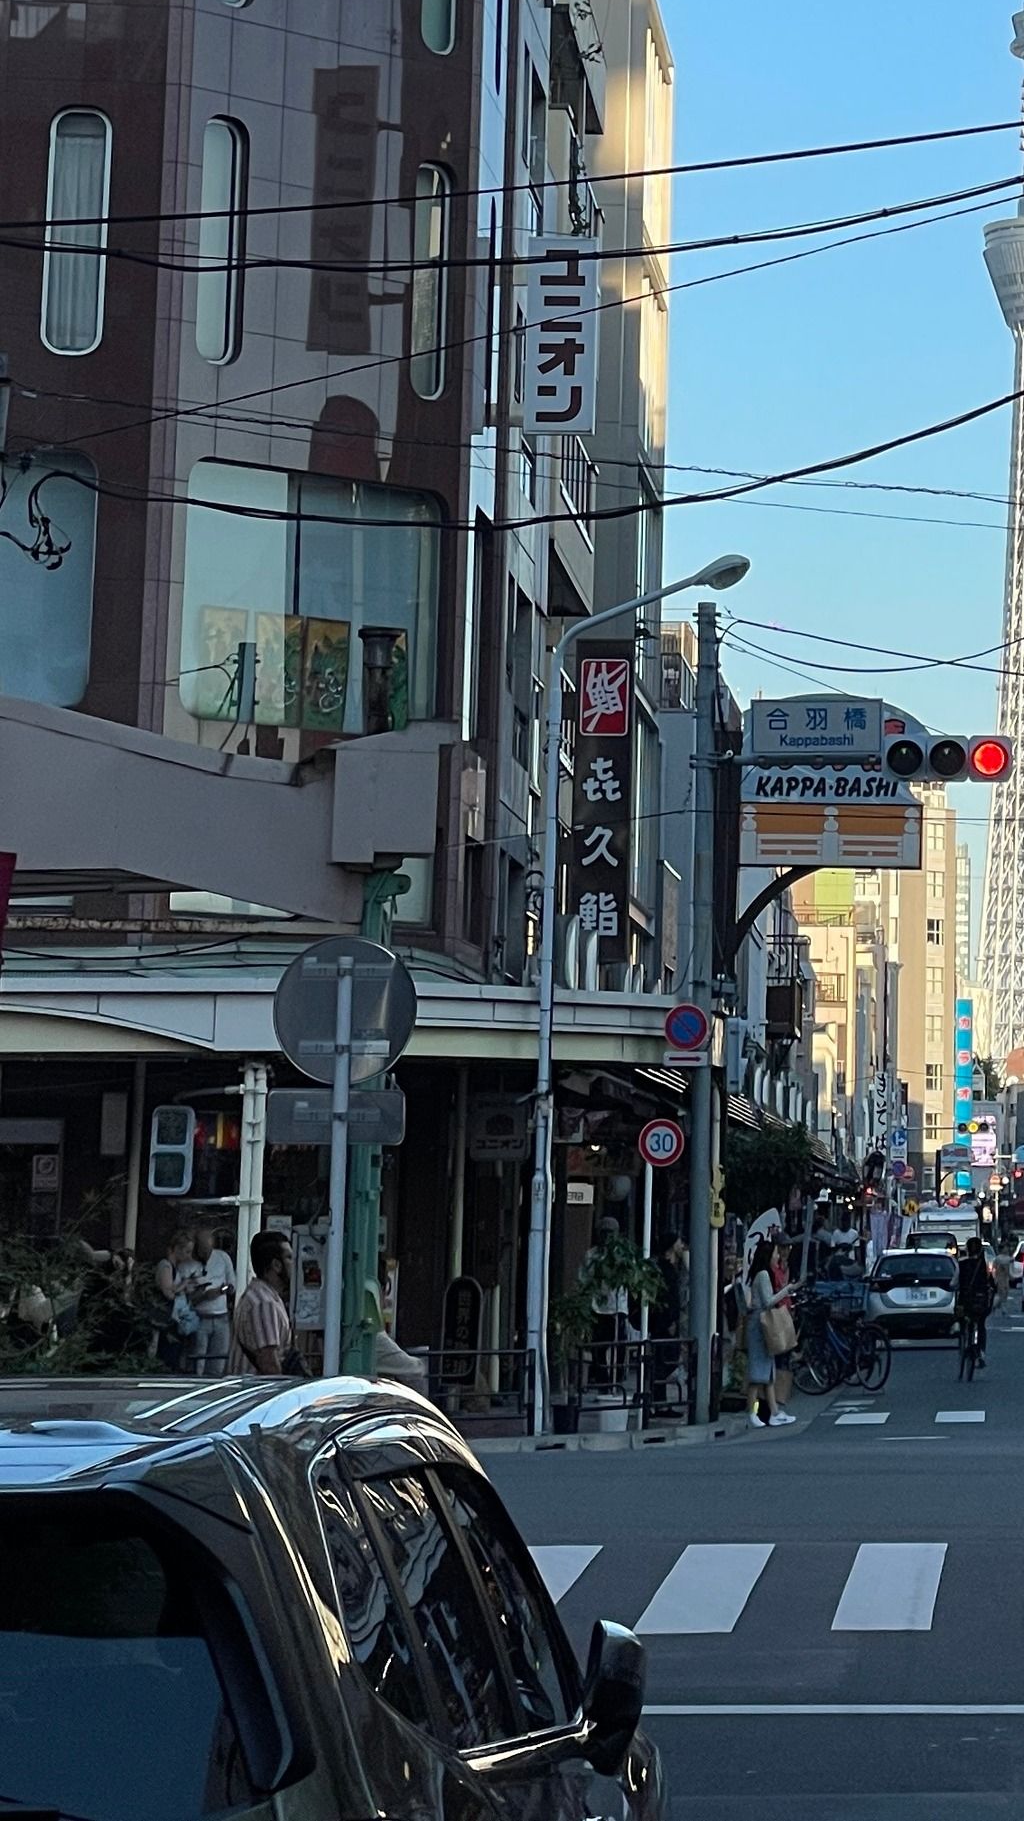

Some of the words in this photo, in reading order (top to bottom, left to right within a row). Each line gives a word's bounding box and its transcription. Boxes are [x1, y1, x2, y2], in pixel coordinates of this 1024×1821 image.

[535, 249, 586, 423] ユニオン
[766, 707, 868, 731] 合羽橋
[779, 733, 855, 747] Kappabashi
[475, 1138, 525, 1150] ユニオン
[649, 1132, 675, 1153] 30
